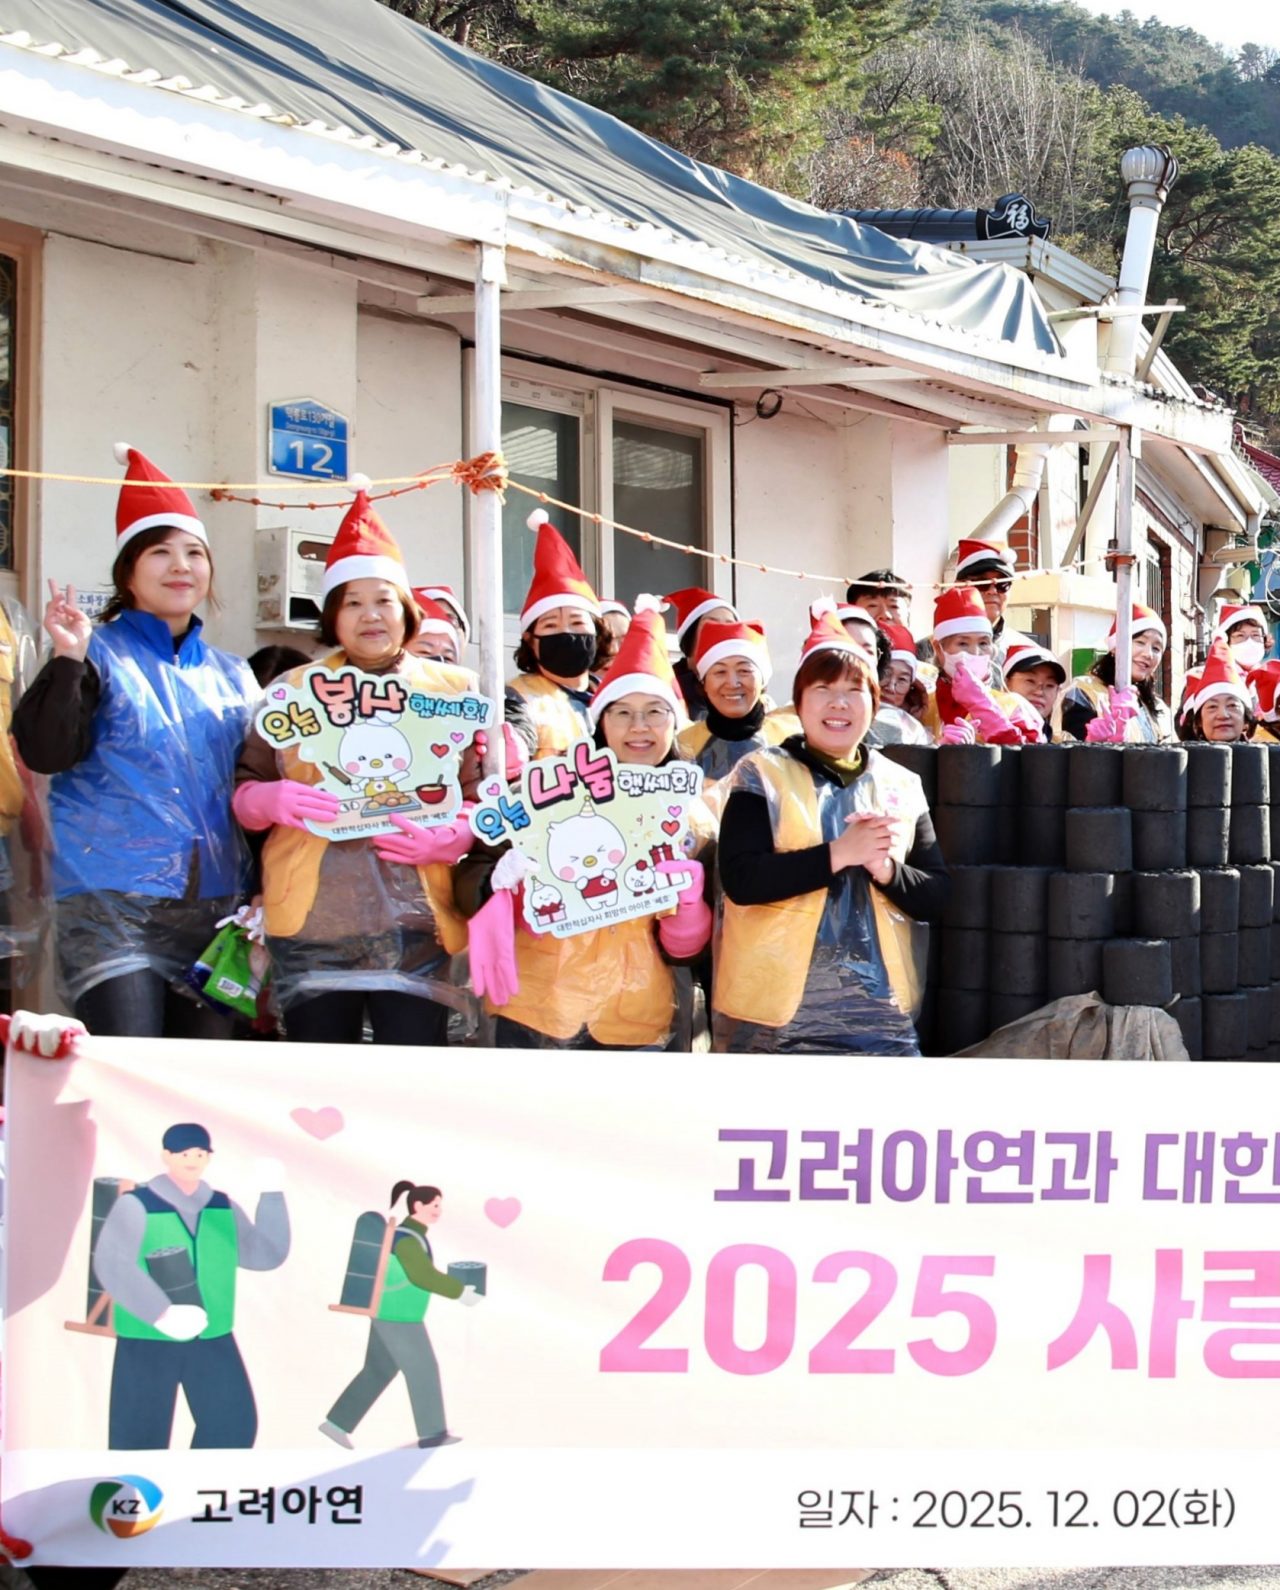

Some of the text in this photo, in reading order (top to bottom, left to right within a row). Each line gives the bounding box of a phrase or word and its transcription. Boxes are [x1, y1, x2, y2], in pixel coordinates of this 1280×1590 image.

[289, 440, 334, 473] 12
[263, 701, 321, 742] 오늘
[310, 672, 408, 727] 봉사
[475, 796, 531, 840] 오늘
[527, 742, 616, 810] 나눔
[714, 1128, 1118, 1204] 고려아연과
[599, 1238, 997, 1377] 2025
[112, 1499, 140, 1514] KZ
[191, 1485, 363, 1524] 고려아연
[797, 1489, 879, 1529] 일자
[912, 1490, 1032, 1529] 2025.
[1046, 1489, 1099, 1528] 12.
[1113, 1487, 1236, 1529] 02(화)
